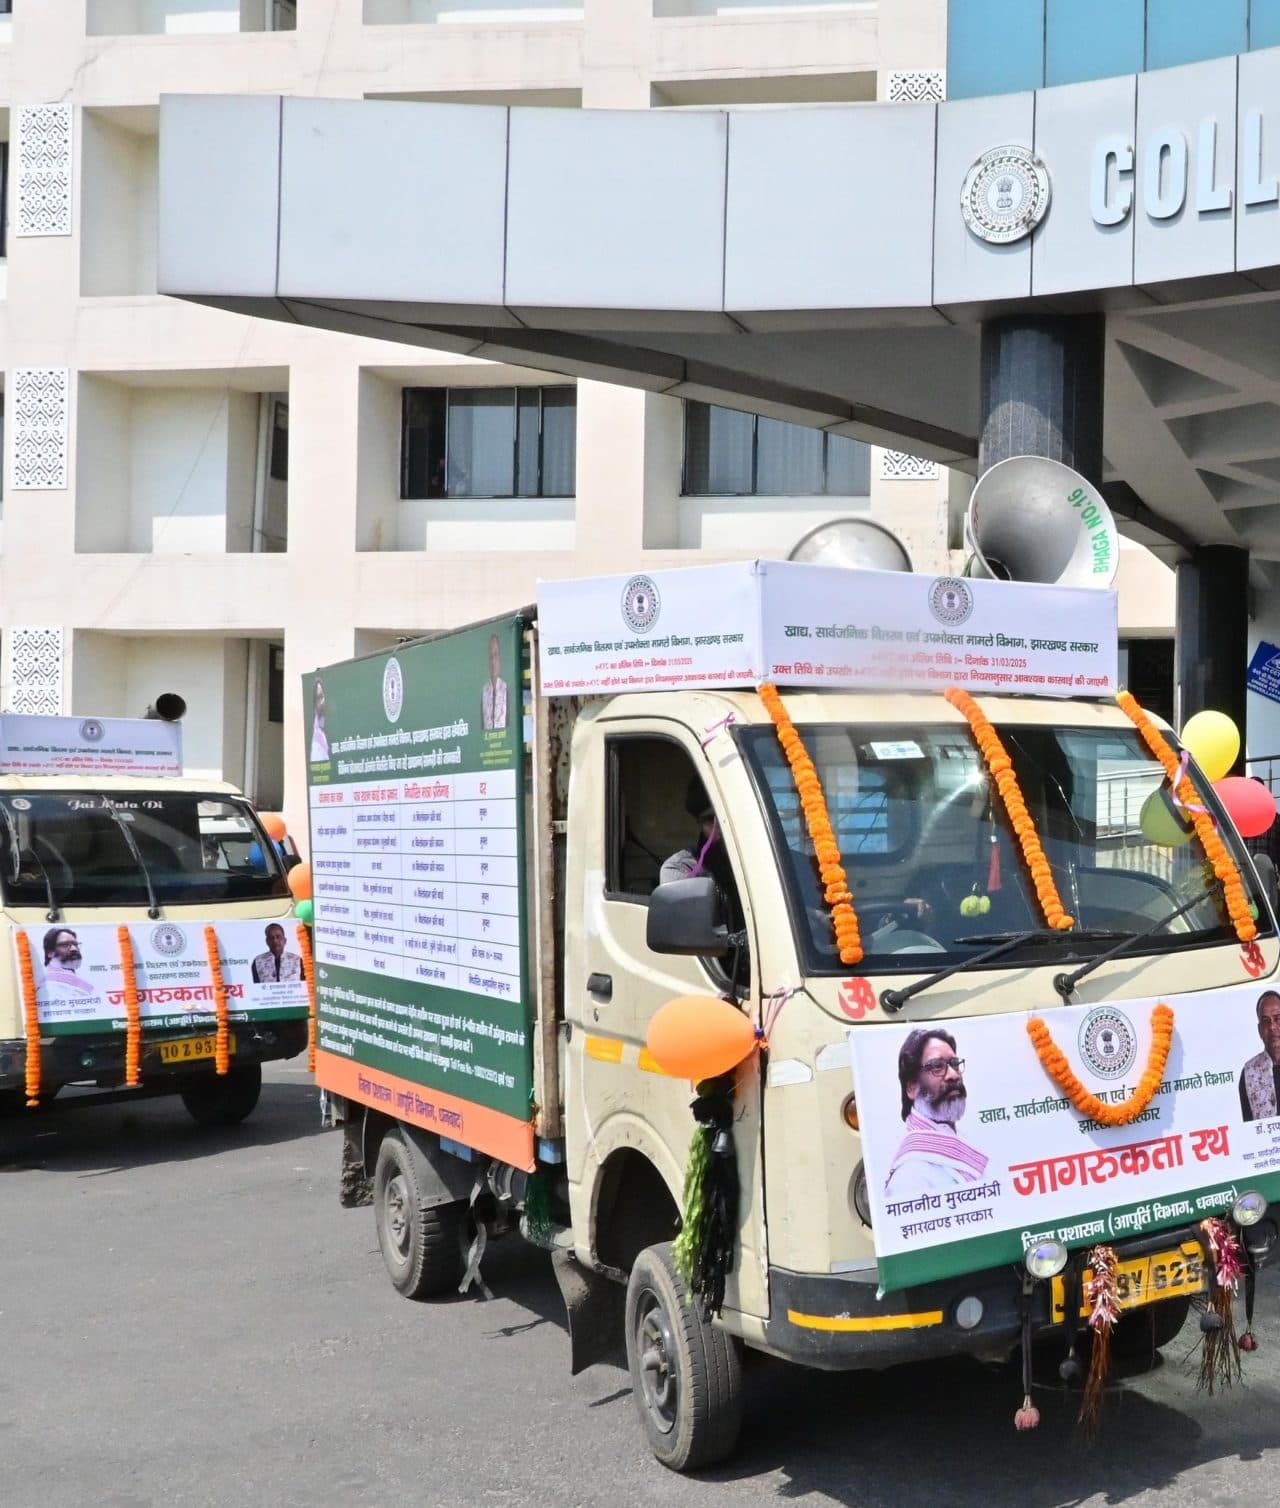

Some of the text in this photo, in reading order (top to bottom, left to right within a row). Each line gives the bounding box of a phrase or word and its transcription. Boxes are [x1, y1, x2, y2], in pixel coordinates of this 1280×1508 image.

[966, 632, 993, 647] मामले
[996, 633, 1027, 649] विभाग,
[1030, 639, 1067, 651] झारखण्ड
[1069, 642, 1099, 653] सरकार
[106, 985, 214, 1006] जगरुकता
[979, 1107, 1010, 1124] खाद्य,
[1013, 1096, 1071, 1119] सार्वजनिक
[1110, 1084, 1126, 1104] एवं
[1174, 1075, 1203, 1091] मामले
[1204, 1070, 1234, 1087] विभाग
[1008, 1125, 1230, 1197] जागरुकता रथ
[885, 1180, 1001, 1217] माननीय मुख्यमंत्री
[1058, 1220, 1104, 1242] प्रशासन
[1108, 1207, 1151, 1236] (आपूर्ति
[1153, 1203, 1194, 1220] विभाग,
[1196, 1185, 1238, 1210] धनबाद)
[900, 1208, 994, 1240] झारखण्ड सरकार
